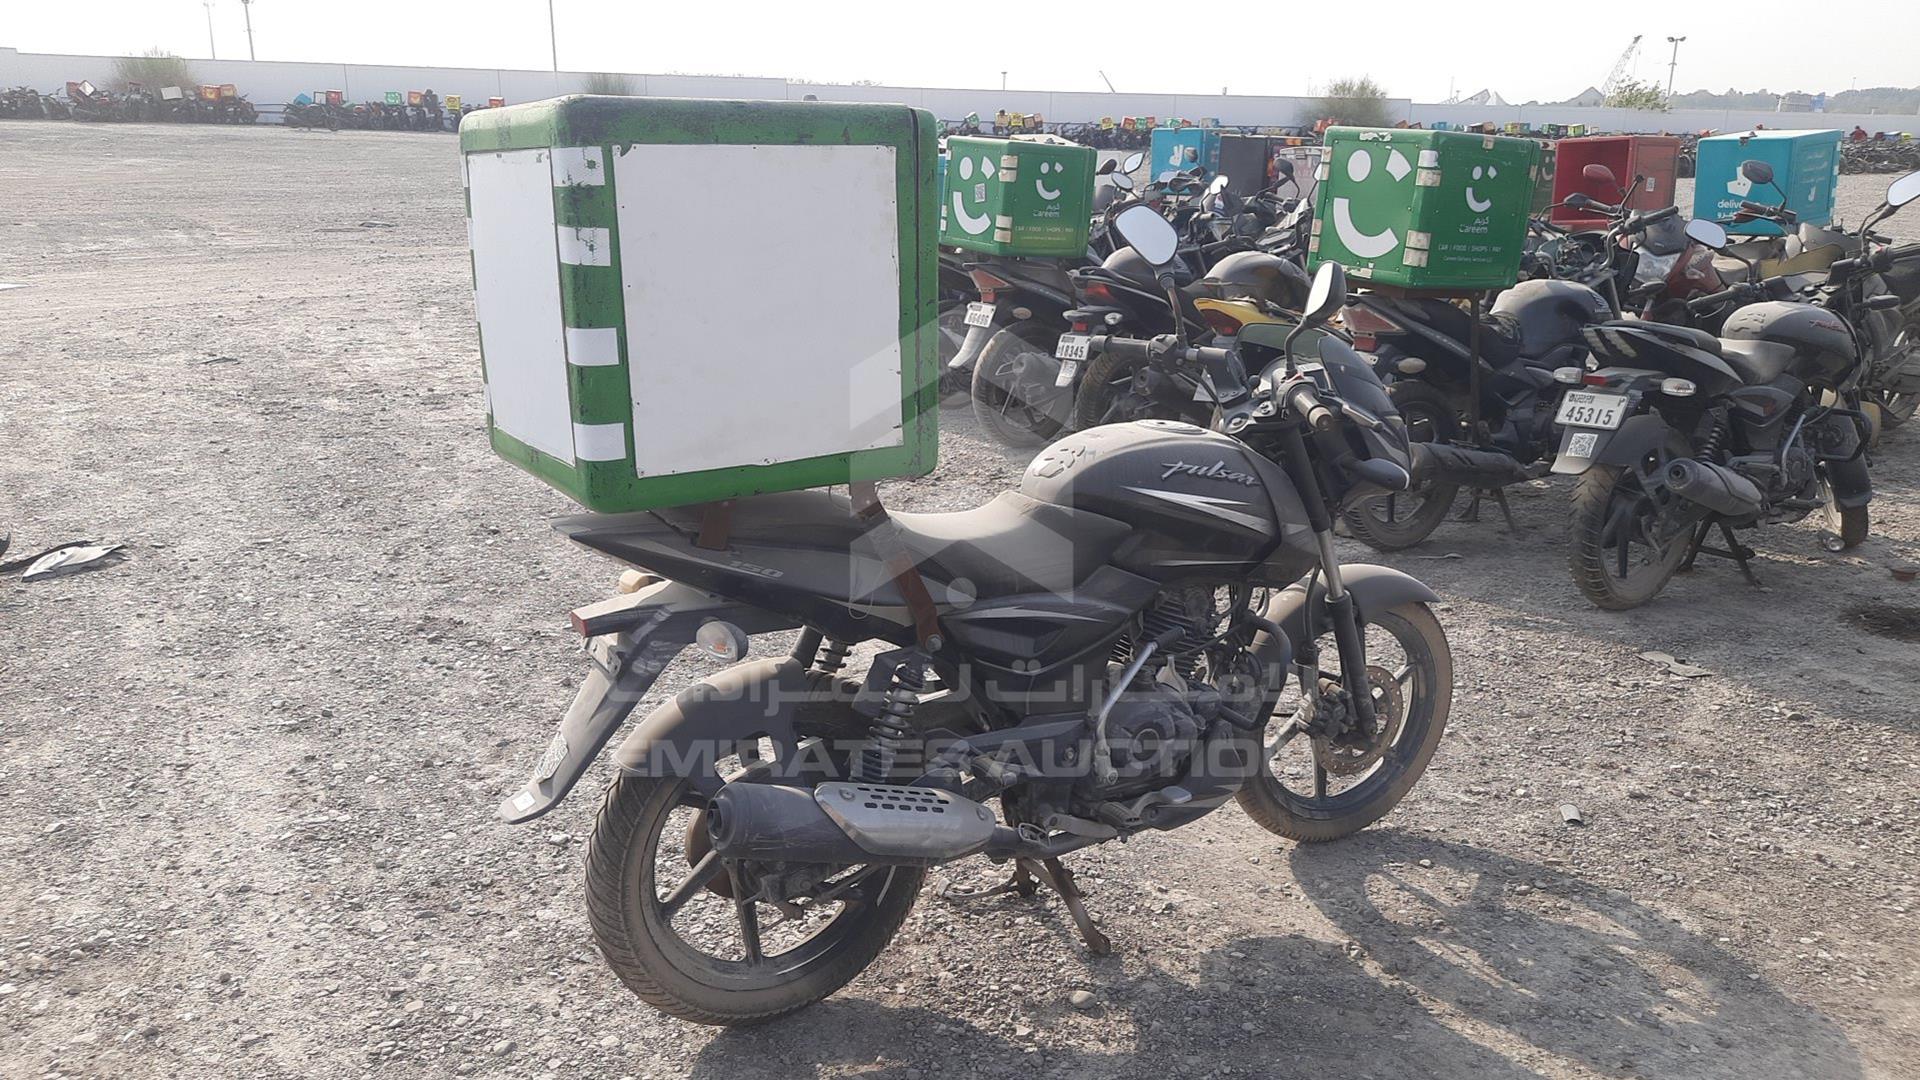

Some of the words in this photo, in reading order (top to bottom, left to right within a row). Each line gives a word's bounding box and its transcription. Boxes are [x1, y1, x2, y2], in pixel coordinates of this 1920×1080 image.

[1459, 223, 1489, 234] Careem
[1060, 344, 1085, 359] 18345
[1566, 406, 1614, 425] 45315
